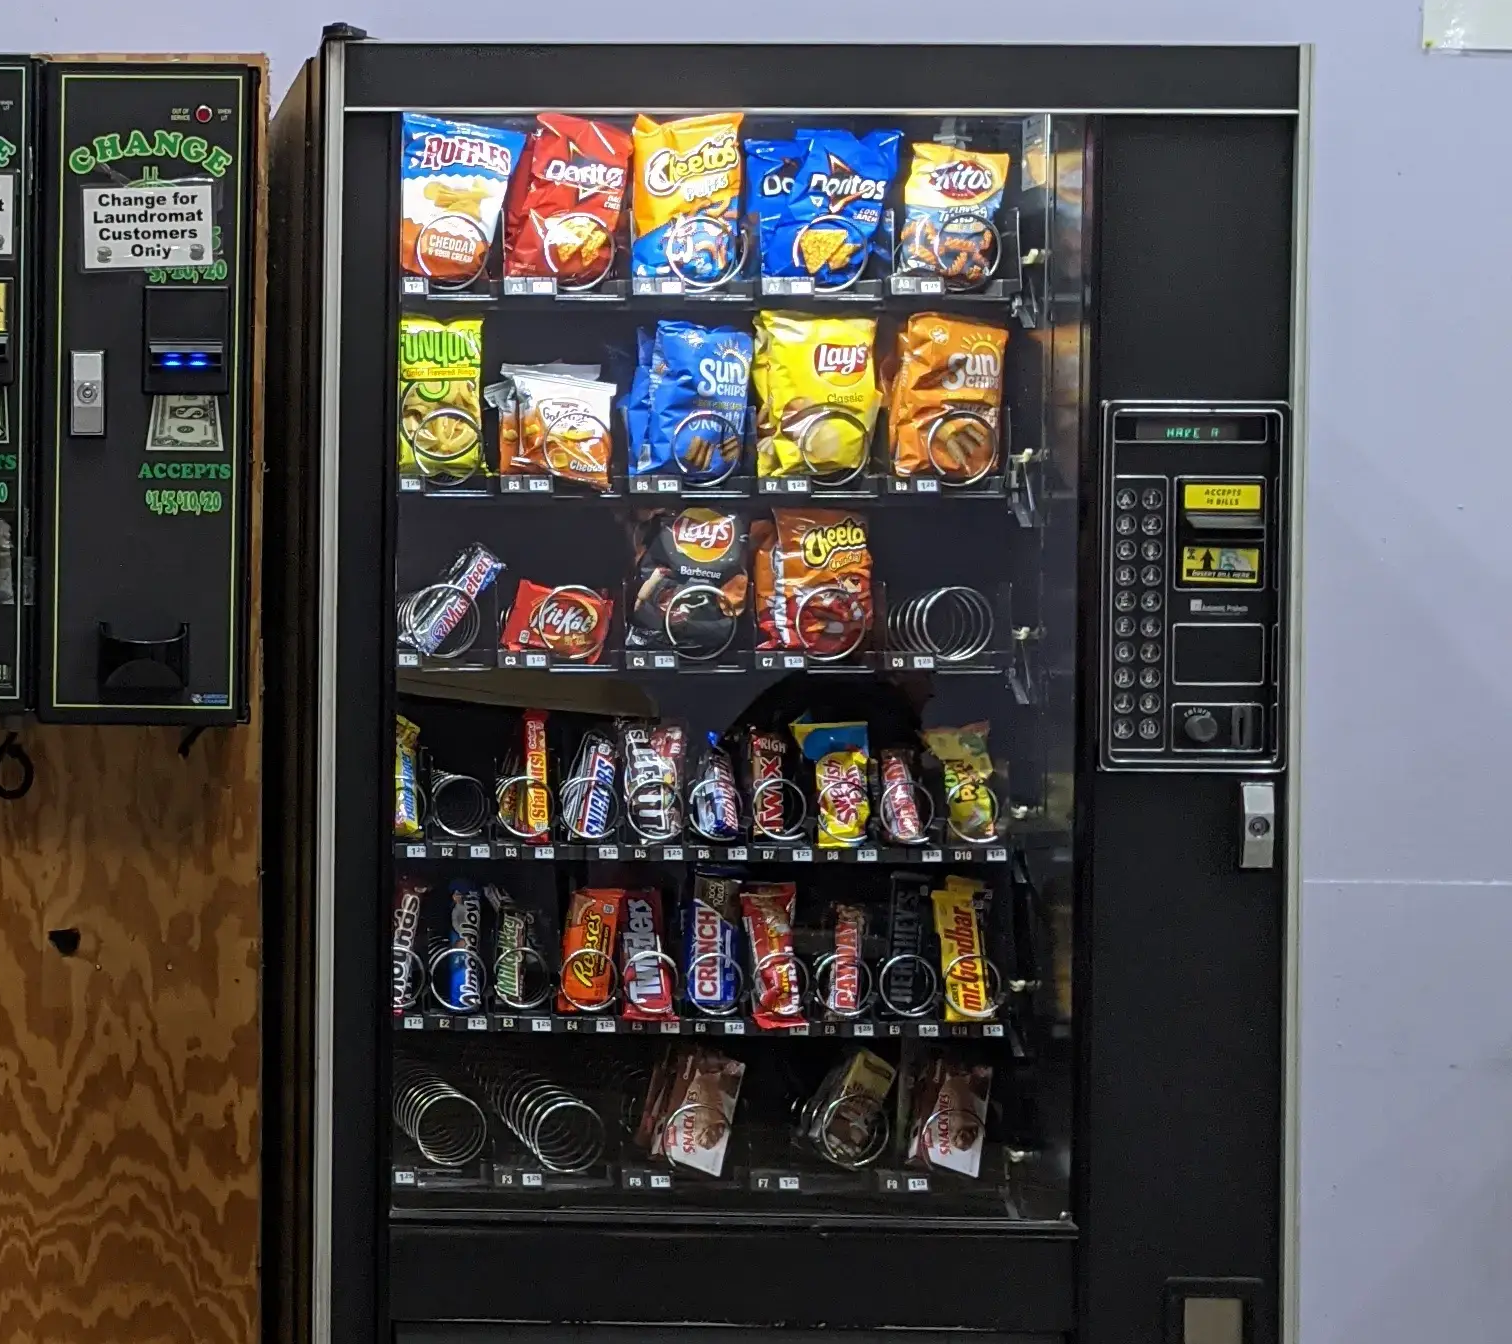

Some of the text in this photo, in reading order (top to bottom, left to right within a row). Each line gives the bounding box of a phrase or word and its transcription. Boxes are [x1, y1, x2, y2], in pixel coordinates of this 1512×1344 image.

[69, 130, 232, 177] CHANGE
[422, 135, 511, 175] RUFFLES
[646, 136, 738, 196] Cheetos
[810, 174, 885, 199] Doritos
[98, 192, 198, 208] Change for
[93, 209, 203, 224] Laundromat
[99, 227, 197, 240] Customers
[429, 234, 476, 254] CHEDDAR
[818, 343, 867, 374] Lay's
[697, 358, 746, 396] Sun
[942, 352, 1001, 389] Sun
[965, 376, 1000, 389] CHIPS
[716, 384, 746, 398] CHIPS
[827, 393, 864, 404] Classic
[138, 463, 231, 479] ACCEPTS
[1148, 520, 1157, 529] 2
[802, 518, 867, 567] Cheeto
[680, 565, 721, 579] Barbecue
[1147, 596, 1155, 606] 5
[1146, 622, 1154, 632] 6
[1145, 698, 1152, 709] 9
[760, 739, 786, 753] RIGH
[442, 847, 453, 857] D2
[506, 847, 517, 857] D3
[763, 850, 774, 859] D7
[697, 911, 719, 998] CRUNCH
